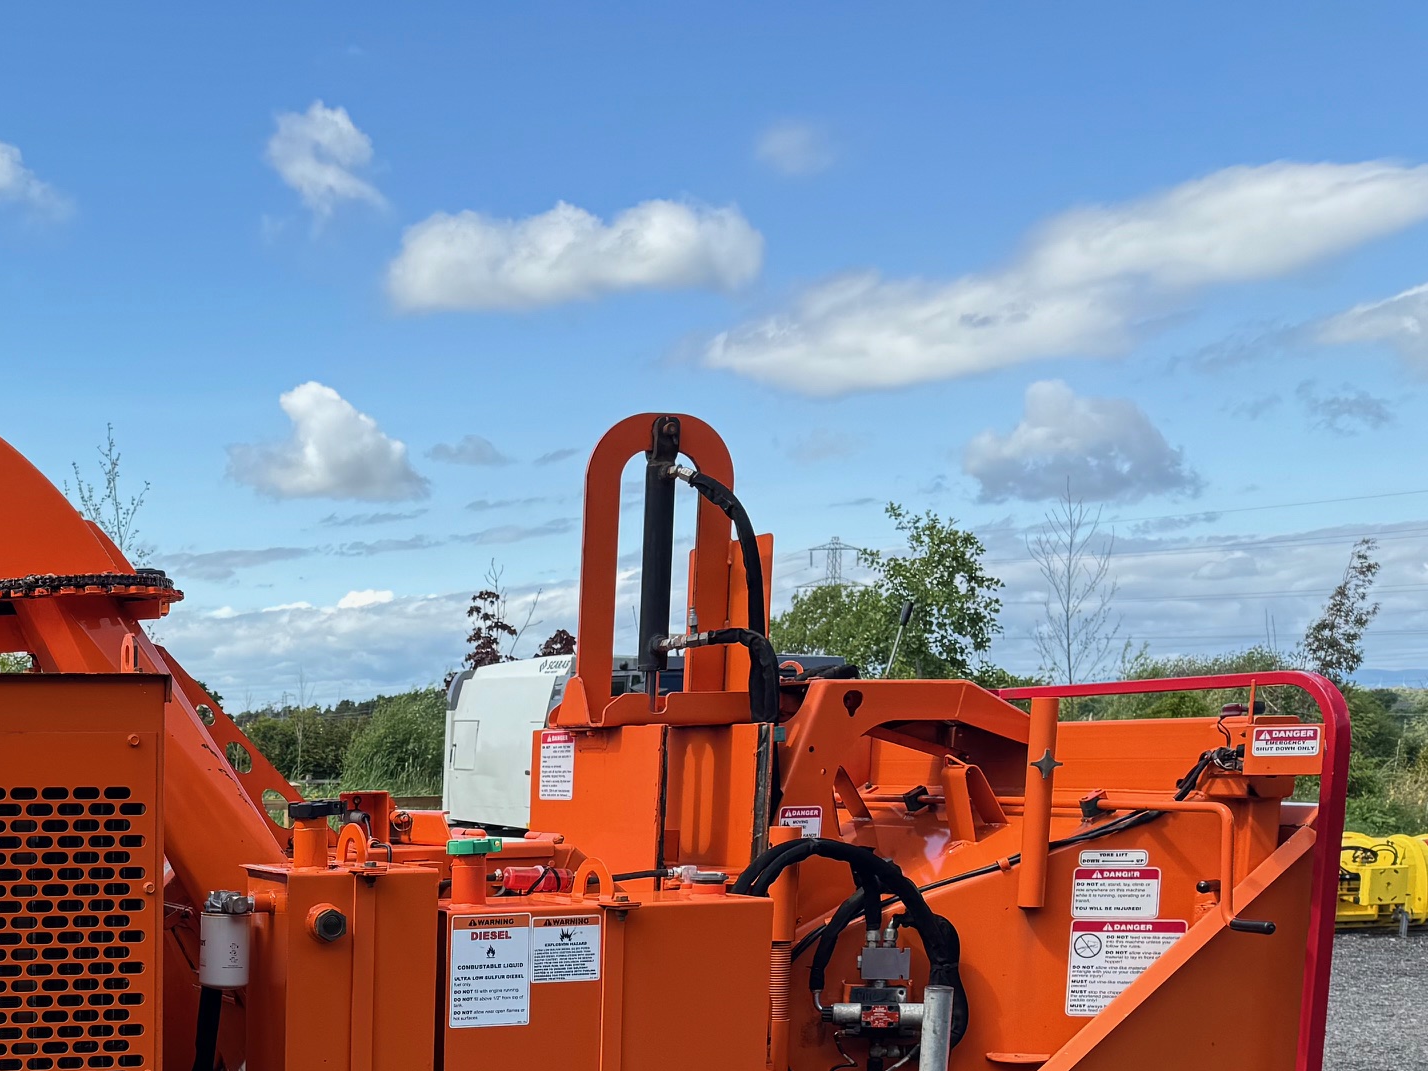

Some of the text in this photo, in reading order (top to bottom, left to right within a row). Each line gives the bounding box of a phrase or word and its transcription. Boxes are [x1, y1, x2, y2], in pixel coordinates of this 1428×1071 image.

[1272, 730, 1314, 738] DANGER
[477, 918, 515, 926] WARNING
[552, 918, 589, 926] WARNING
[470, 930, 512, 941] DIESEL
